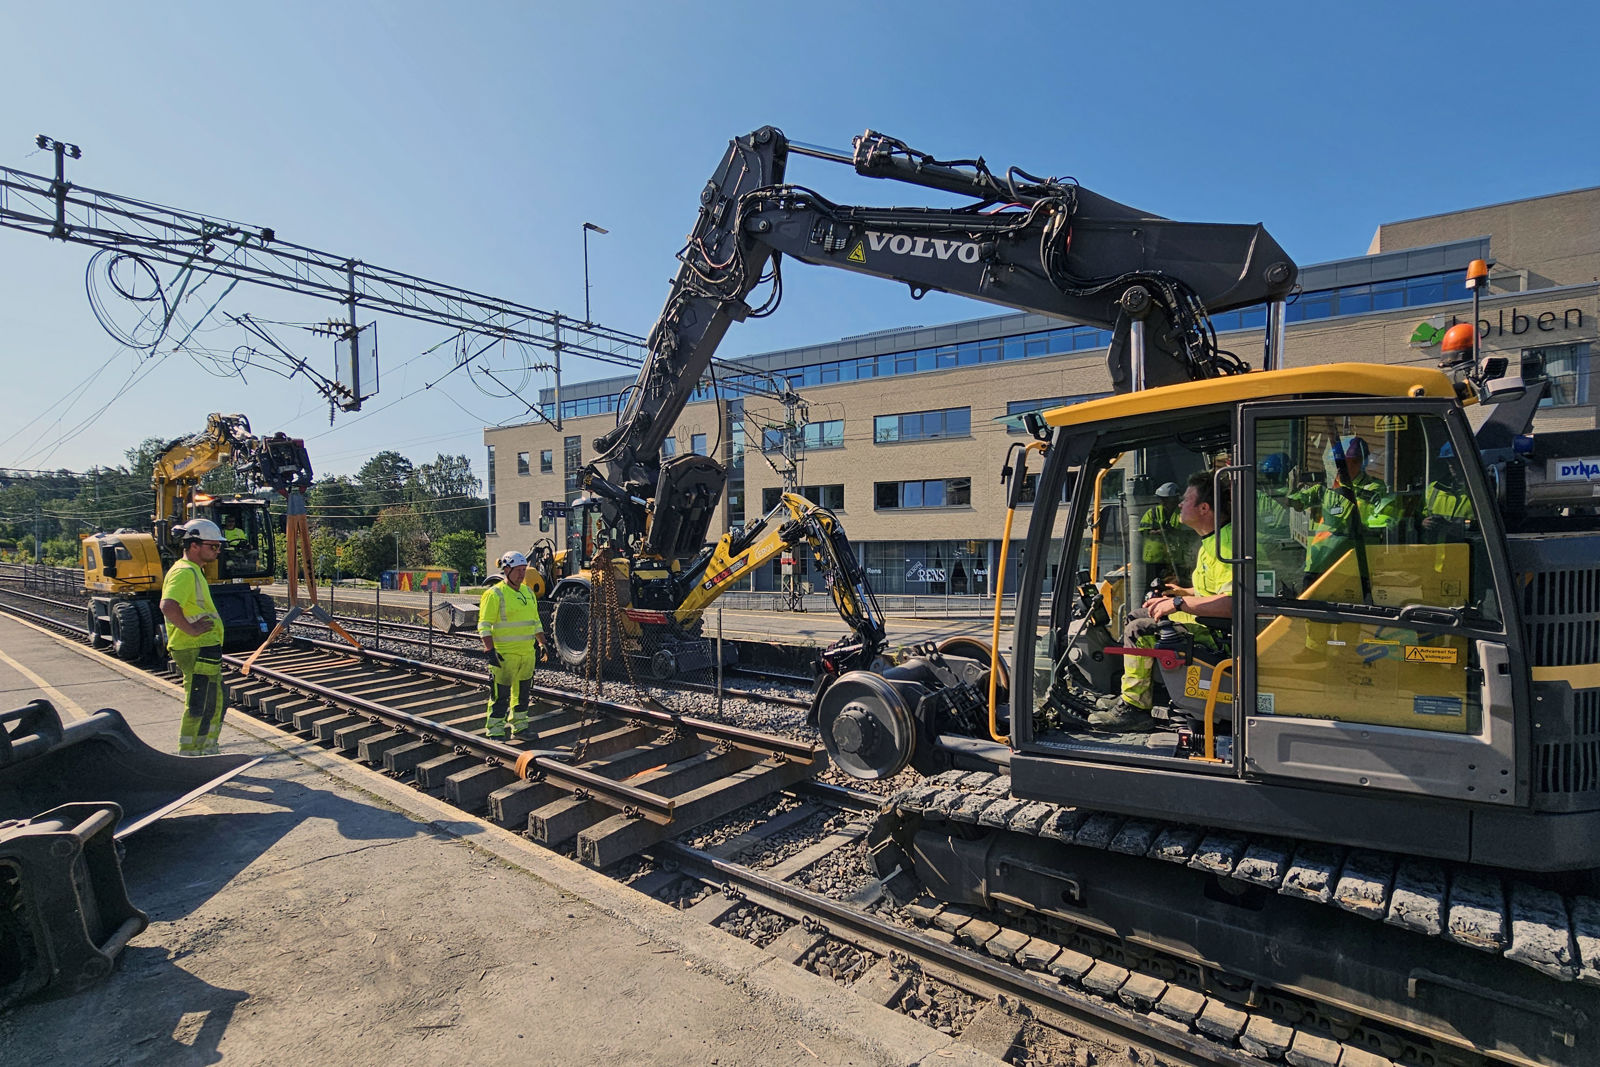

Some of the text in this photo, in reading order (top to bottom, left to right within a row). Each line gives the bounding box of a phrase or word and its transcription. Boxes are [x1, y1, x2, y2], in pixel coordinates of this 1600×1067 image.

[865, 231, 980, 263] VOLVO
[1452, 307, 1583, 339] olben
[866, 567, 882, 575] Rens
[918, 568, 946, 582] RENS
